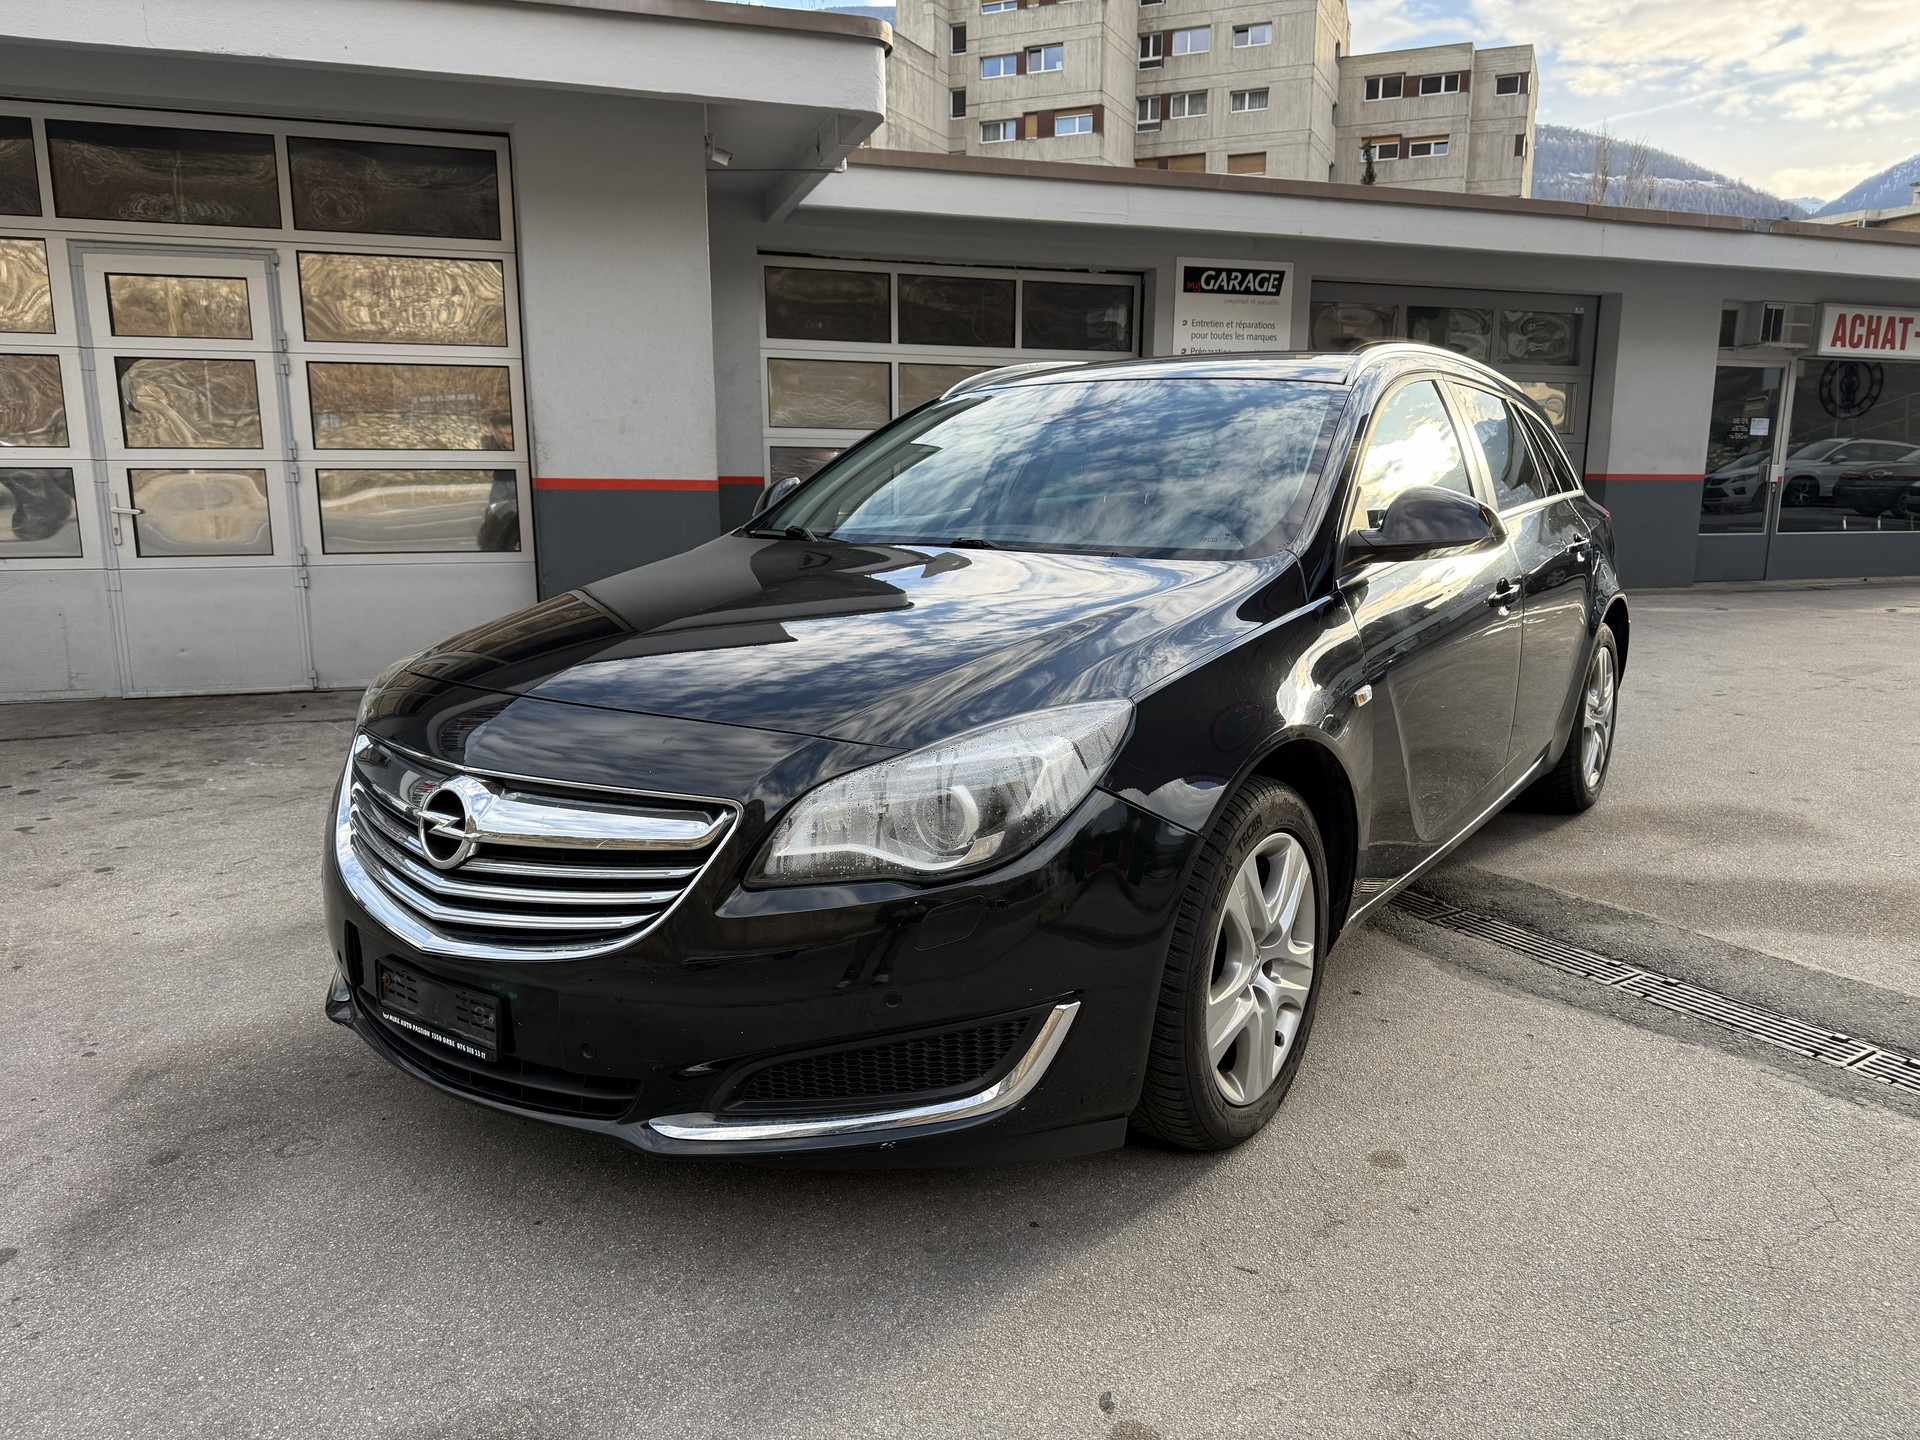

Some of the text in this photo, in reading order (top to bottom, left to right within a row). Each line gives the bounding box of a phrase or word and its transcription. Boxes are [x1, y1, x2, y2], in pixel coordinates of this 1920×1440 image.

[1191, 319, 1276, 330] Entretien et réparations
[1190, 332, 1278, 342] pour toutes les marques
